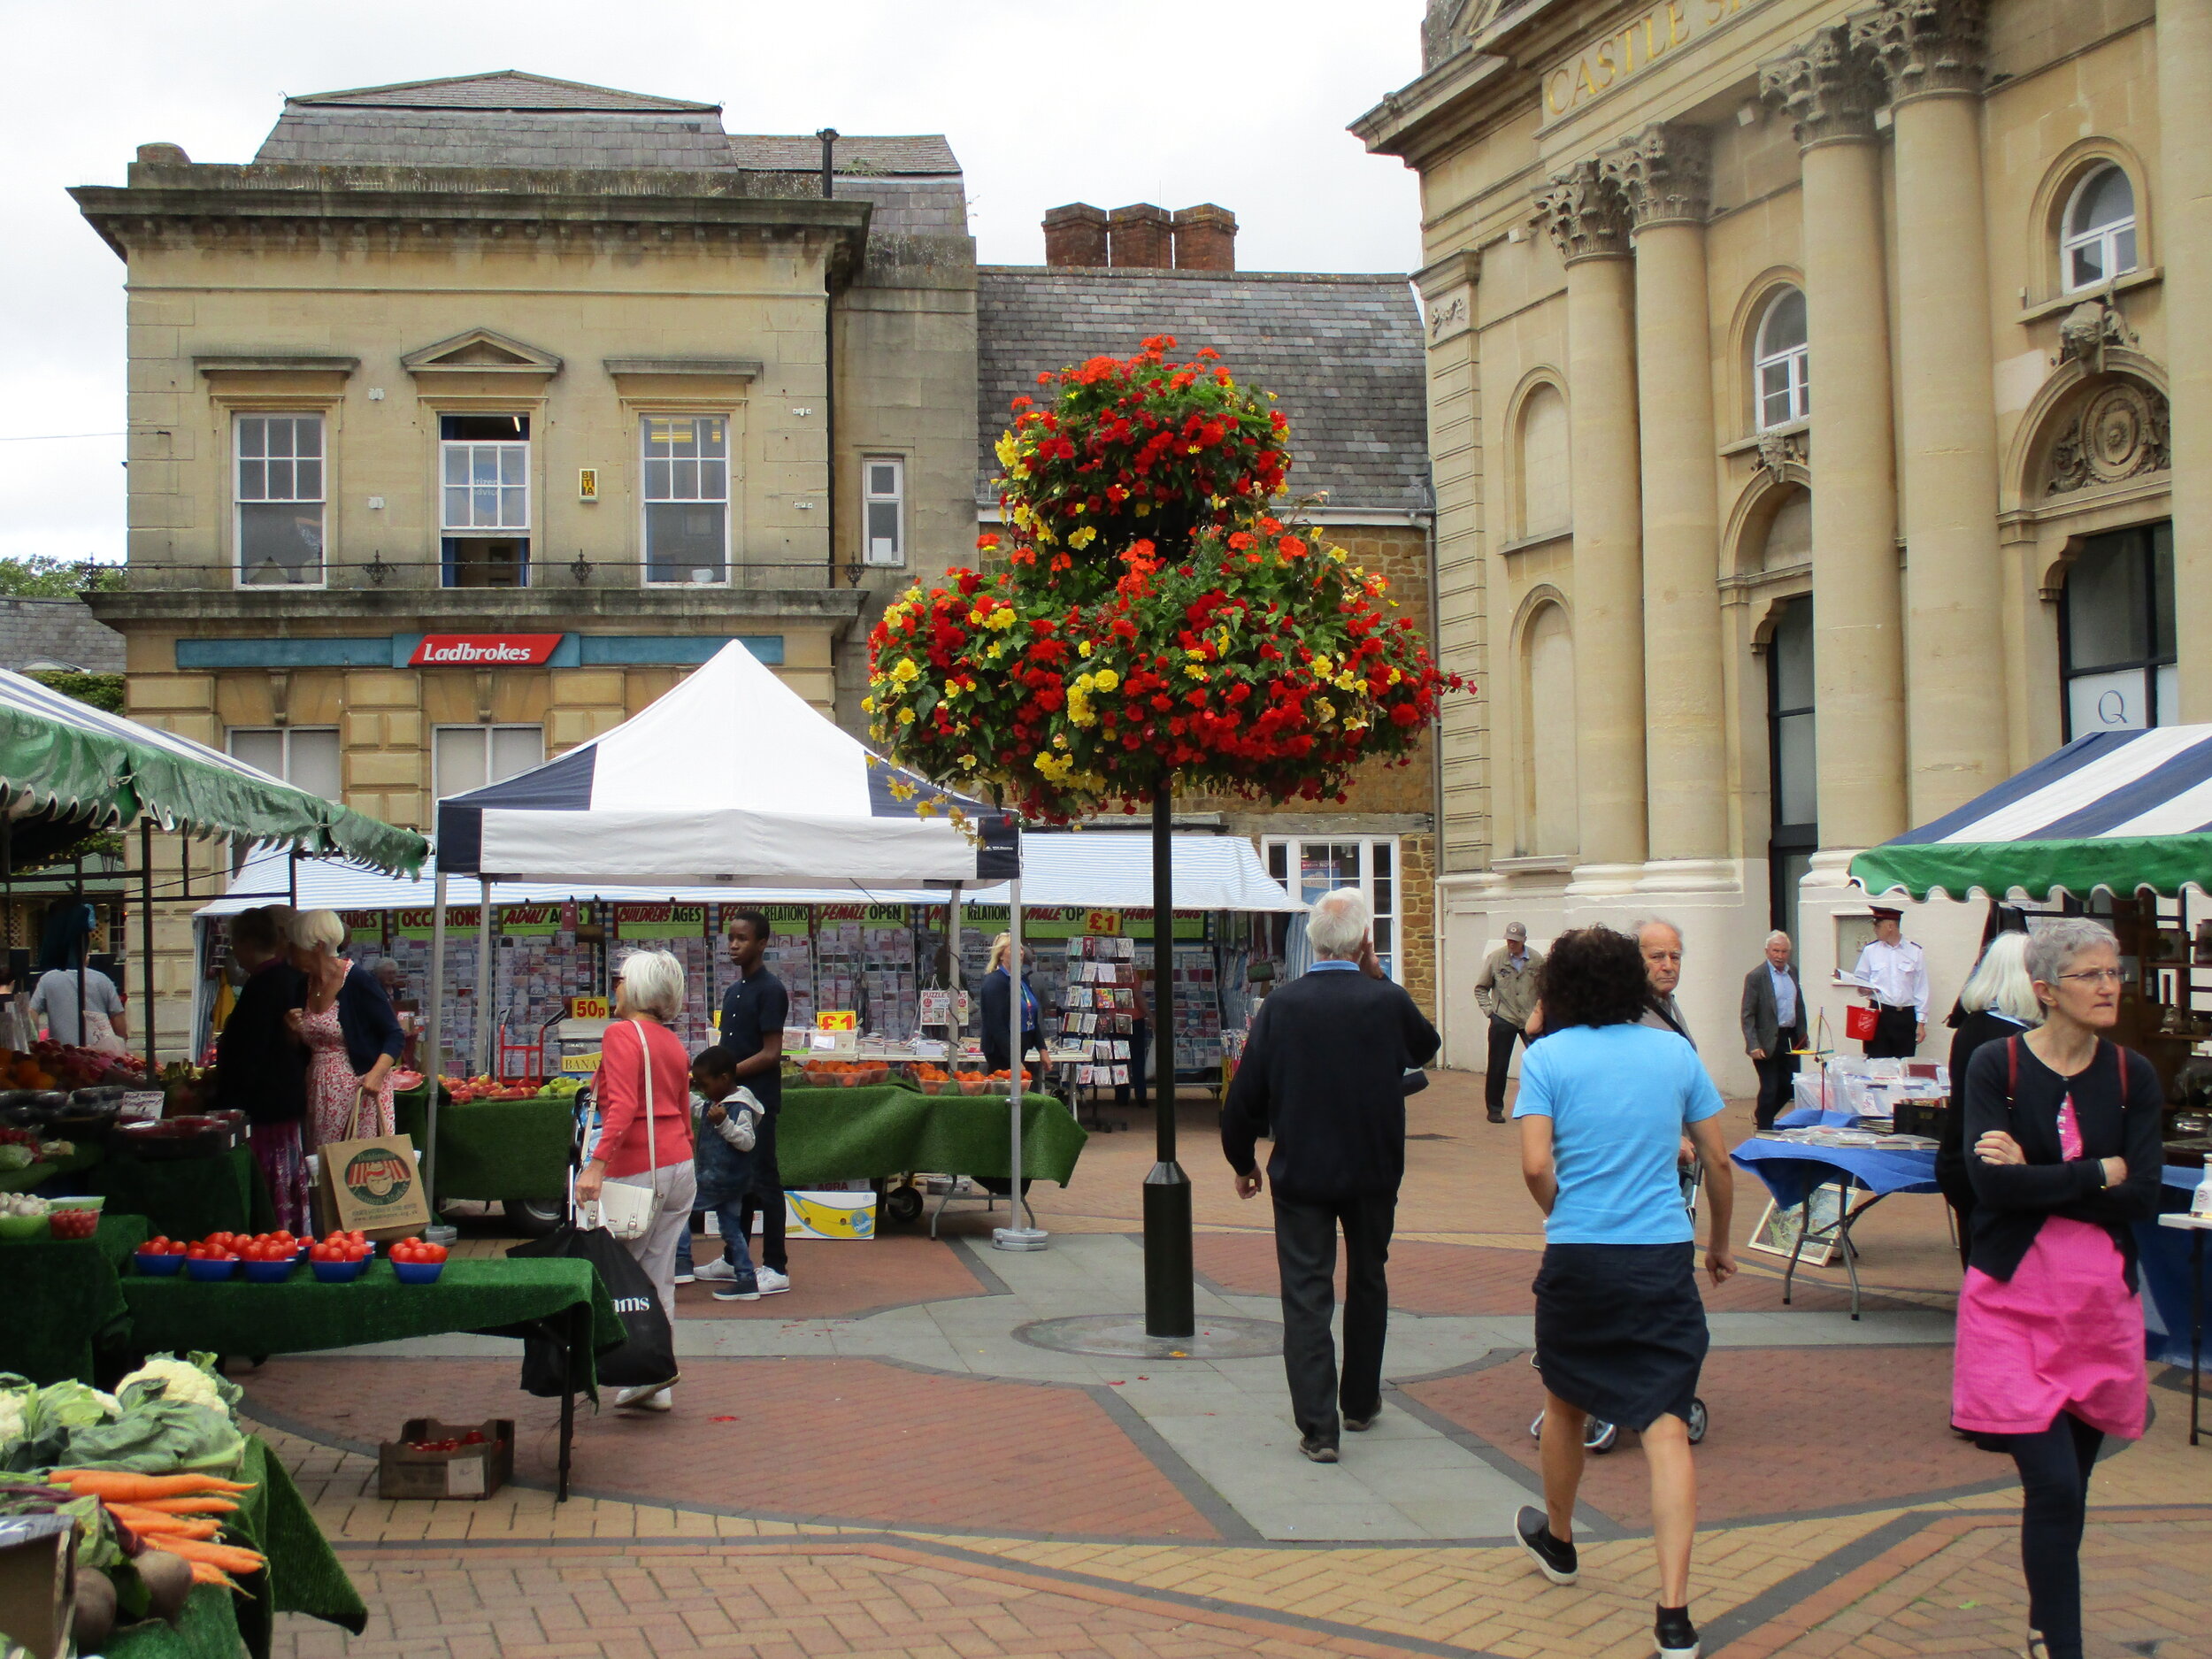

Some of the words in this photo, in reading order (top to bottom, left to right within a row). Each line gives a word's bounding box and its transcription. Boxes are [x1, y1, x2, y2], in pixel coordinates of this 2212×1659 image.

[1547, 0, 1691, 116] CASTLE
[423, 642, 531, 662] Ladbrokes
[2098, 689, 2128, 725] Q
[503, 908, 549, 925] ADULT
[618, 906, 672, 923] CHILDRENS
[672, 907, 702, 923] AGES
[764, 905, 808, 921] RELATIONS
[822, 904, 866, 920] FEMALE
[869, 904, 902, 920] OPEN
[1025, 907, 1063, 921] MALE
[1089, 912, 1115, 932] £1
[576, 1000, 606, 1018] 50p
[821, 1015, 853, 1031] £1
